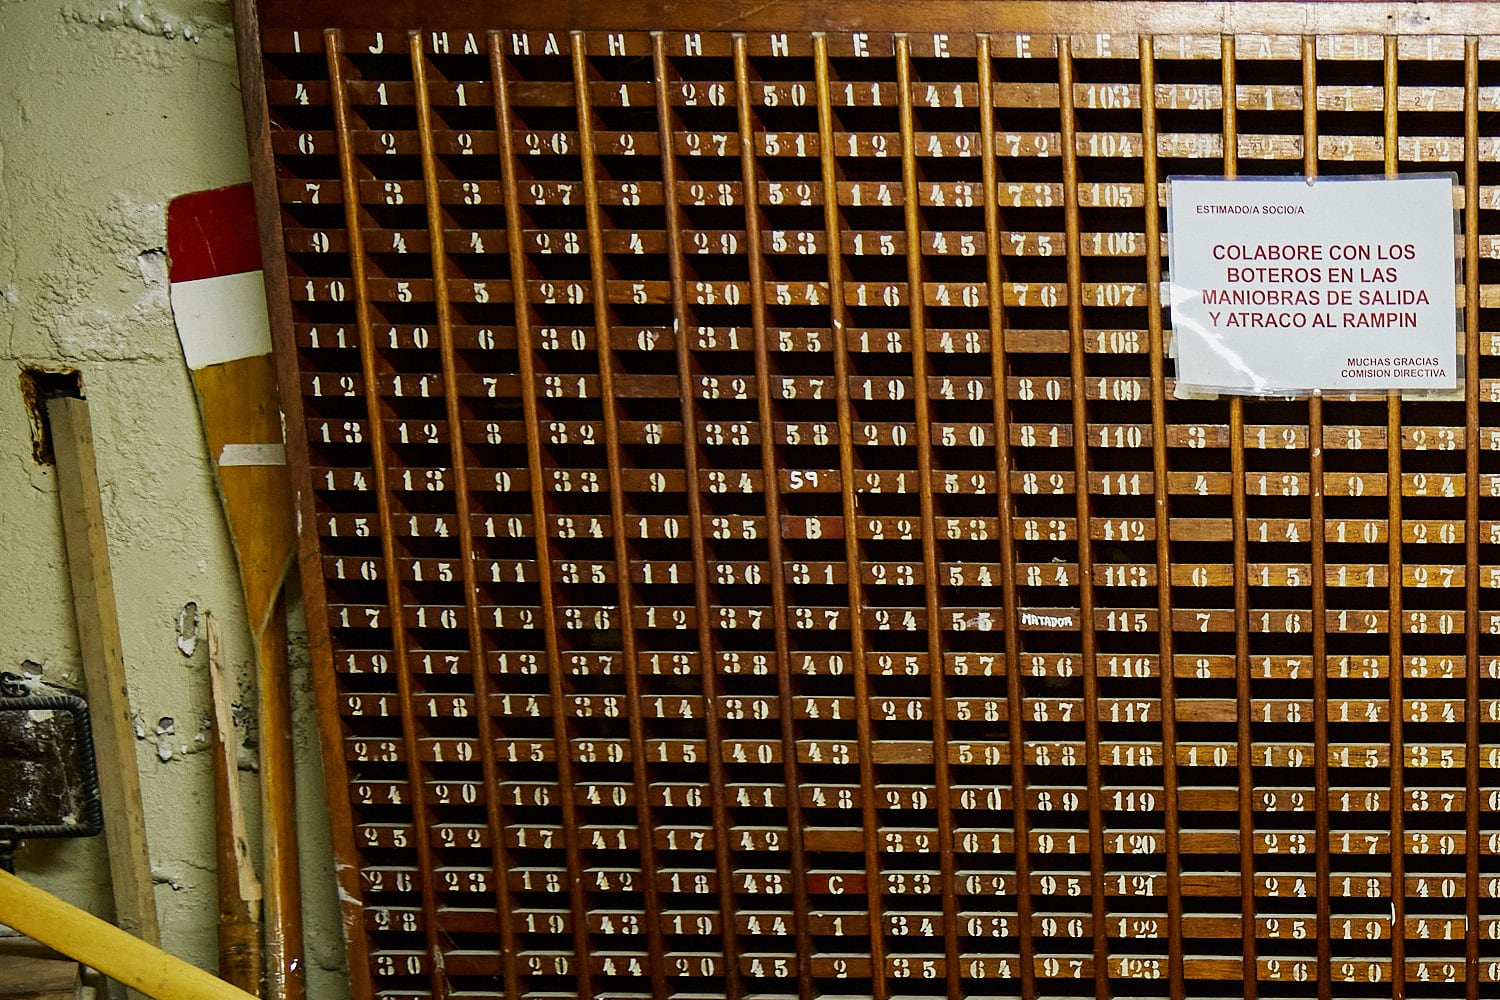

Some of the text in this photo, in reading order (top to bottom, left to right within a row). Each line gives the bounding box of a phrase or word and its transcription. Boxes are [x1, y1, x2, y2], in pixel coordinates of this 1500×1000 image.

[294, 31, 300, 52] I
[369, 33, 383, 53] J
[609, 34, 625, 56] H
[685, 34, 701, 56] H
[771, 34, 788, 56] H
[853, 33, 869, 57] E
[934, 35, 949, 57] E
[1016, 35, 1031, 58] E
[1096, 34, 1111, 56] E
[295, 84, 309, 105] 4
[377, 83, 387, 105] 1
[456, 84, 466, 106] 1
[619, 84, 630, 106] 1
[1088, 84, 1133, 109] 103
[299, 134, 314, 154] 6
[381, 134, 396, 154] 2
[458, 134, 472, 154] 2
[620, 134, 634, 155] 2
[1089, 133, 1136, 157] 104
[306, 184, 320, 204] 7
[385, 183, 403, 204] 3
[463, 183, 481, 204] 3
[1089, 183, 1135, 207] 105
[1196, 205, 1304, 214] ESTIMADO/A SOCIO/A
[312, 232, 328, 252] 9
[393, 233, 407, 253] 4
[471, 232, 484, 253] 4
[1213, 244, 1416, 260] COLABORE CON LOS
[1227, 268, 1397, 283] BOTEROS EN LAS
[398, 283, 411, 302] 5
[474, 283, 488, 303] 5
[633, 284, 647, 304] 5
[1202, 290, 1429, 305] MANIOBRAS DE SALIDA
[1209, 312, 1417, 328] Y ATRACO AL RAMPIN
[479, 330, 494, 349] 6
[1097, 330, 1142, 353] 108
[1347, 357, 1439, 366] MUCHAS GRACIAS
[1341, 369, 1445, 377] COMISION DIRECTIVA
[483, 378, 497, 397] 7
[1098, 377, 1140, 401] 109
[487, 424, 501, 444] 8
[645, 424, 661, 444] 8
[1100, 427, 1141, 447] 110
[1188, 427, 1205, 448] 3
[1348, 428, 1361, 449] 8
[496, 472, 510, 491] 9
[790, 471, 817, 489] 59
[1102, 474, 1140, 495] 111
[1195, 475, 1208, 495] 4
[1348, 477, 1363, 496] 9
[806, 518, 821, 539] B
[1105, 564, 1147, 586] 113
[1192, 568, 1207, 587] 6
[1107, 611, 1147, 632] 115
[1197, 613, 1210, 632] 7
[1196, 659, 1210, 678] 8
[1111, 703, 1150, 722] 117
[1112, 746, 1153, 766] 118
[1115, 835, 1155, 854] 120
[829, 876, 843, 894] C
[1117, 874, 1155, 896] 121
[834, 918, 843, 936] 1
[834, 961, 847, 978] 2
[1120, 958, 1160, 979] 123
